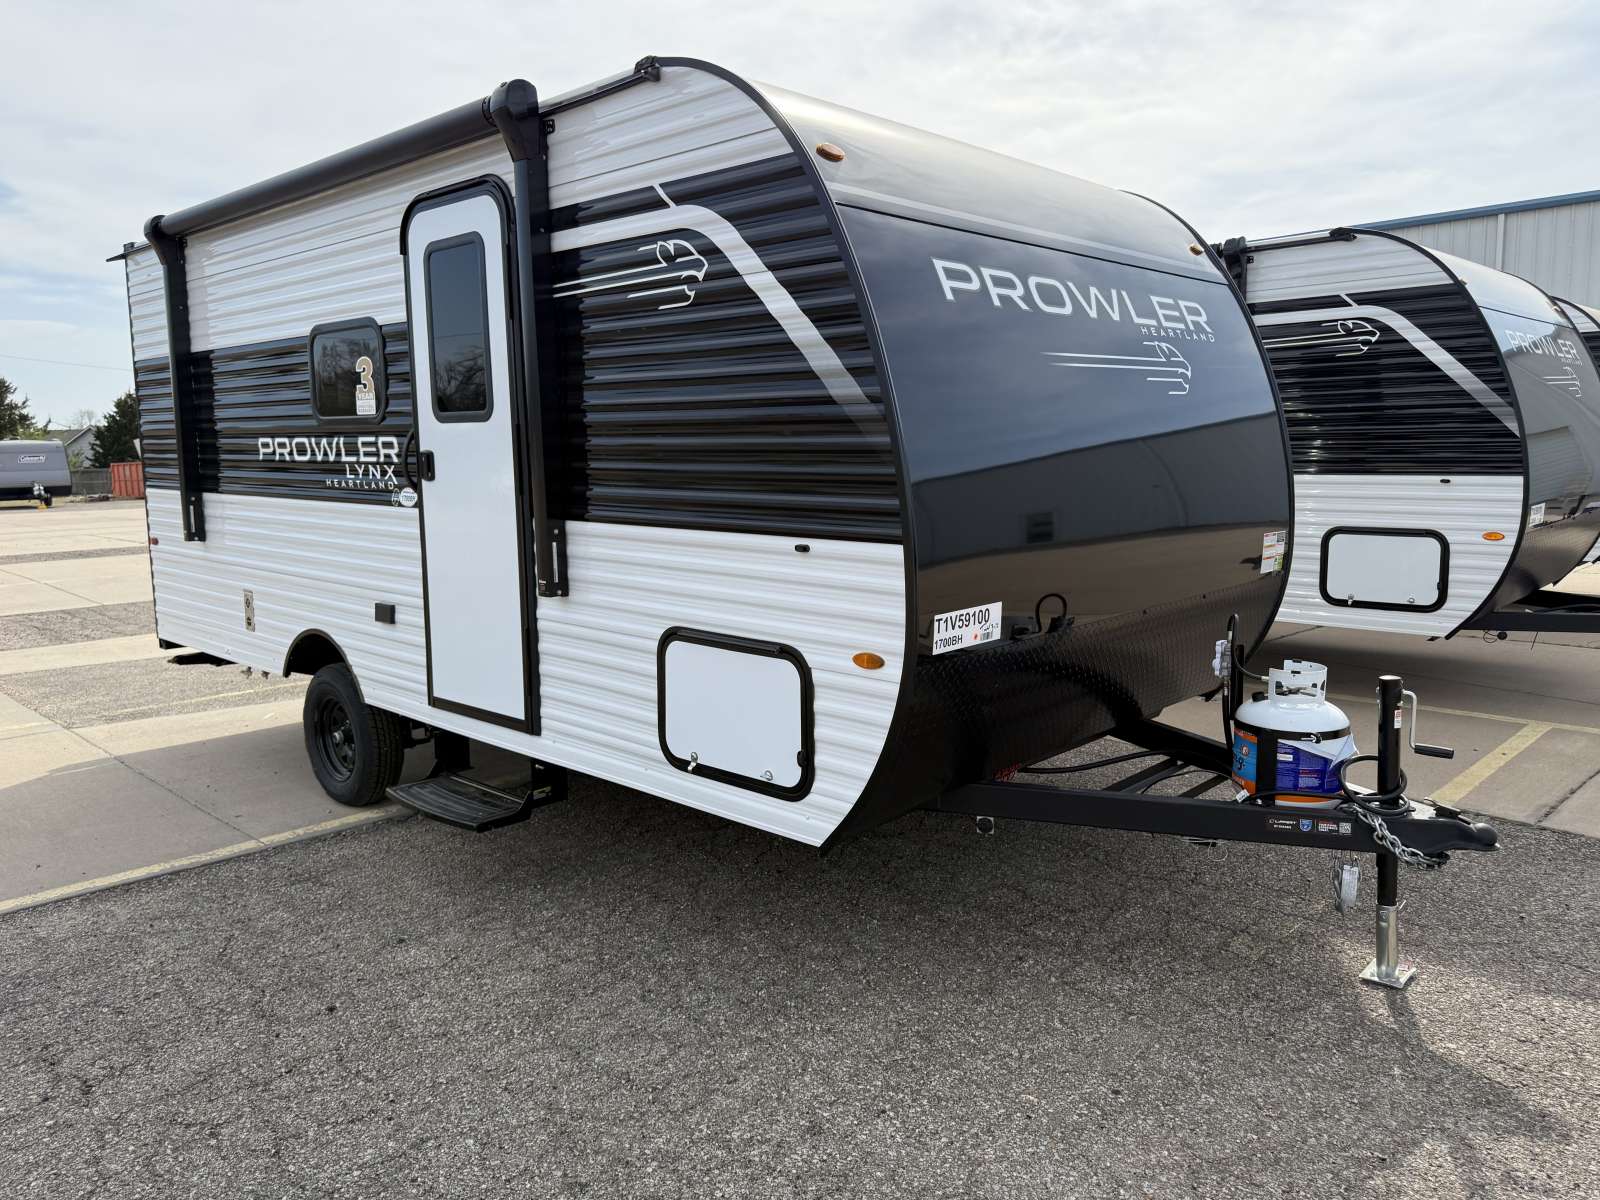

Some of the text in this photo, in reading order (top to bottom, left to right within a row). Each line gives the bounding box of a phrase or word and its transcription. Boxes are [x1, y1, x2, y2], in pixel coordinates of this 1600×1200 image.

[931, 256, 1213, 333] PROWLER
[1140, 325, 1215, 343] HEARTLAND
[1504, 329, 1580, 360] PROWLER
[356, 356, 375, 393] 3
[258, 436, 400, 463] PROWLER
[326, 478, 394, 490] HEARTLAND
[345, 463, 398, 484] LYNX
[935, 607, 990, 634] T1V59100
[934, 633, 963, 650] 1700BH
